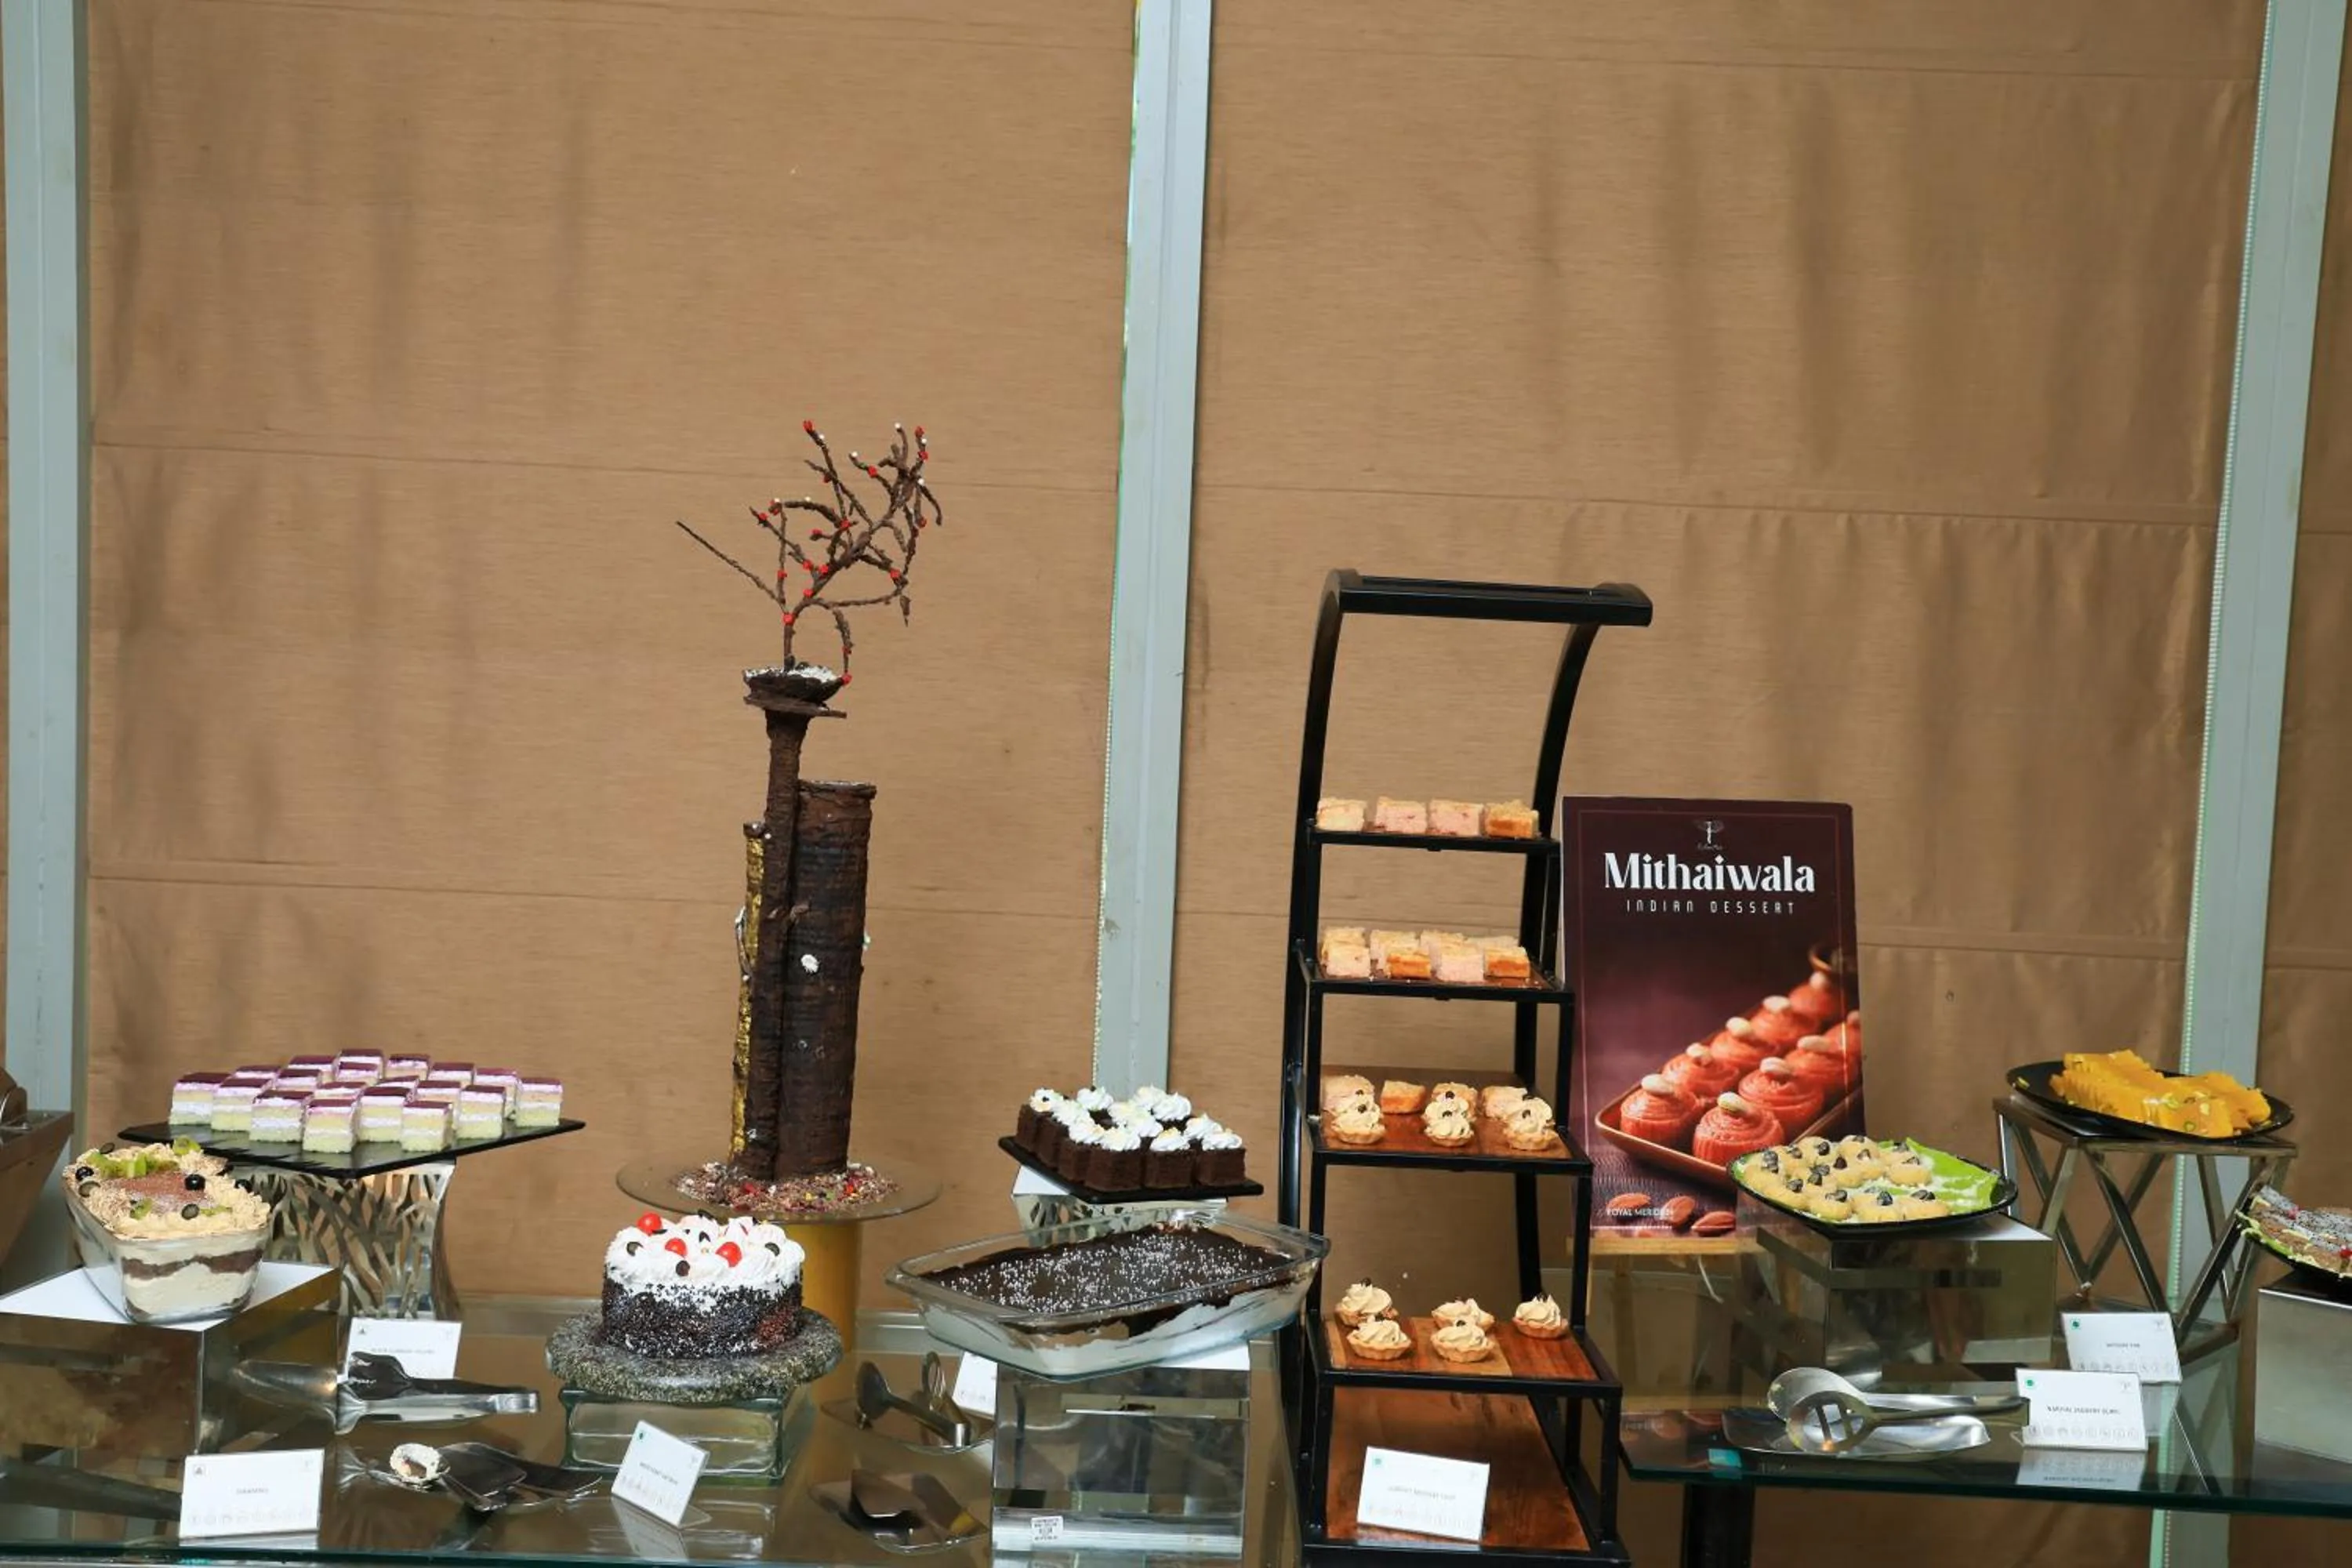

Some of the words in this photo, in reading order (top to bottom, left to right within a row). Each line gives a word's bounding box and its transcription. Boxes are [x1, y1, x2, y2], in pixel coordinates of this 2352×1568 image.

[1604, 851, 1816, 893] Mithaiwala
[1626, 899, 1694, 913] INDIAN
[1709, 901, 1795, 914] DESSERT
